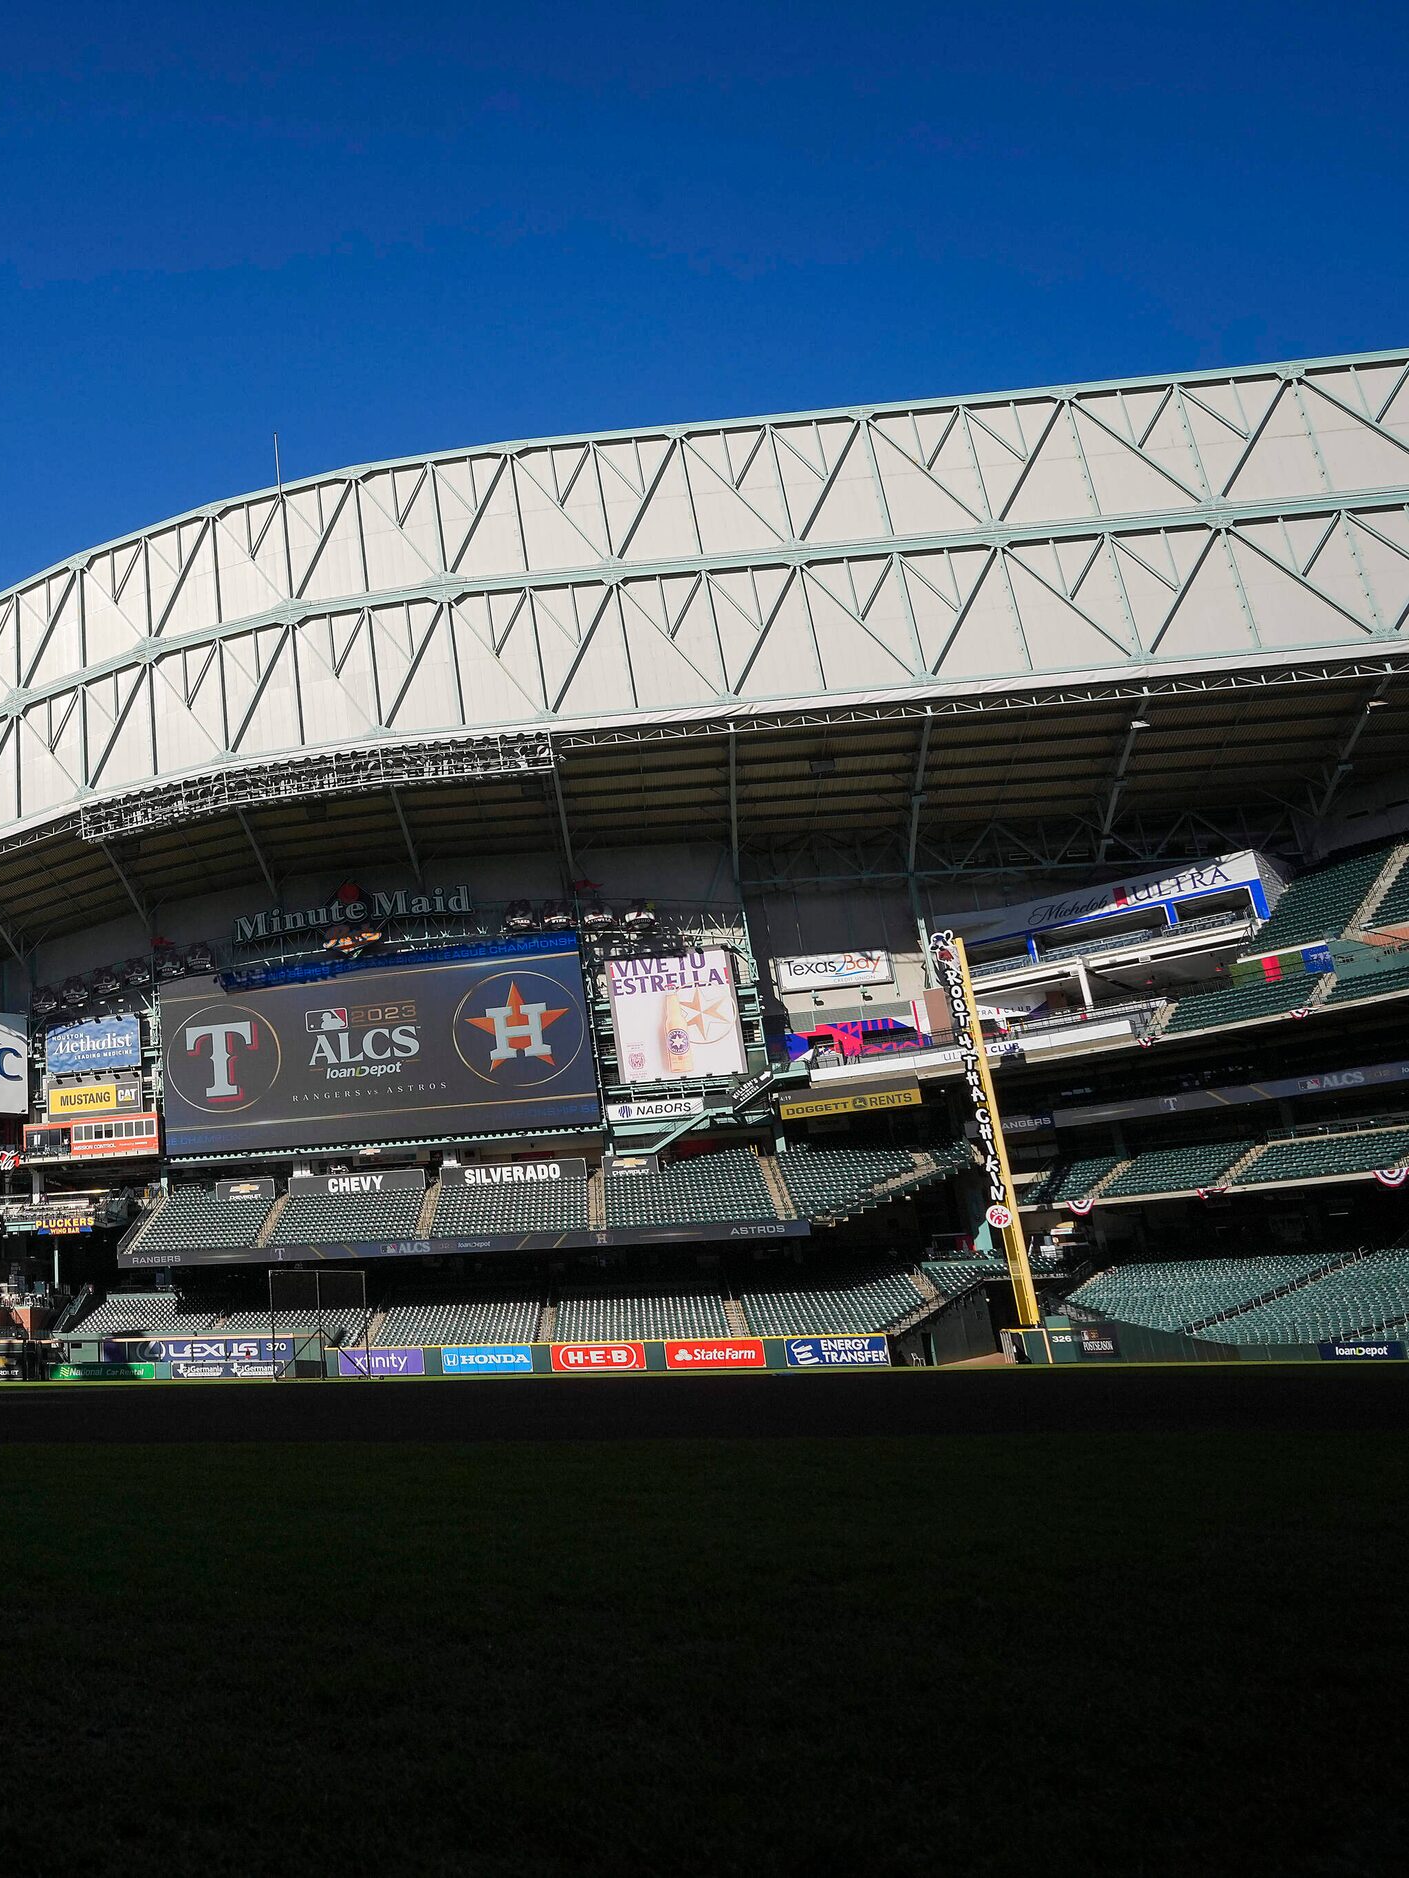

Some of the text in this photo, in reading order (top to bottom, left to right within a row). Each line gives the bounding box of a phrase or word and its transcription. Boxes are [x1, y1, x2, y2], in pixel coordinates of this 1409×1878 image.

[1027, 866, 1231, 927] Michelob ULTRA
[234, 899, 367, 943] Minute
[372, 885, 473, 918] Maid
[435, 947, 485, 961] LEAGUE
[679, 951, 706, 971] TU
[783, 954, 881, 978] Texas Bay
[944, 969, 971, 1028] ROOT
[351, 1004, 417, 1023] 2023
[52, 1032, 85, 1041] HOUSTON
[486, 1001, 552, 1062] H
[55, 1031, 132, 1056] Methodist
[308, 1025, 420, 1066] ALCS
[990, 1042, 1020, 1053] CLUB
[103, 1049, 133, 1058] MEDICINE
[185, 1020, 257, 1102] T
[326, 1061, 402, 1080] loanDepot
[962, 1053, 986, 1104] THA
[1323, 1071, 1365, 1088] ALCS
[117, 1087, 138, 1102] CAT
[292, 1081, 448, 1102] RANGERS ASTROS
[732, 1077, 759, 1100] KILLEN'S
[60, 1091, 111, 1107] MUSTANG
[786, 1092, 912, 1117] DOGGETT RENTS
[636, 1102, 691, 1116] NABORS
[974, 1107, 1007, 1202] CHIKIN
[327, 1163, 562, 1193] CHEVY SILVERADO
[35, 1216, 95, 1229] PLUCKERS
[68, 1226, 80, 1234] BAR
[730, 1224, 786, 1235] ASTROS
[399, 1242, 432, 1254] ALCS
[132, 1255, 182, 1265] RANGERS
[265, 1342, 287, 1352] 370
[820, 1338, 870, 1351] ENERGY
[1051, 1335, 1072, 1343] 326
[1082, 1340, 1114, 1351] POSTSEASON
[168, 1341, 259, 1357] LEXUS
[567, 1349, 628, 1364] H-E-B
[822, 1350, 886, 1364] TRANSFER
[1334, 1345, 1389, 1357] loanDepot
[354, 1352, 409, 1372] xfinity
[460, 1353, 530, 1365] HONDA
[70, 1366, 145, 1377] National Car Rental
